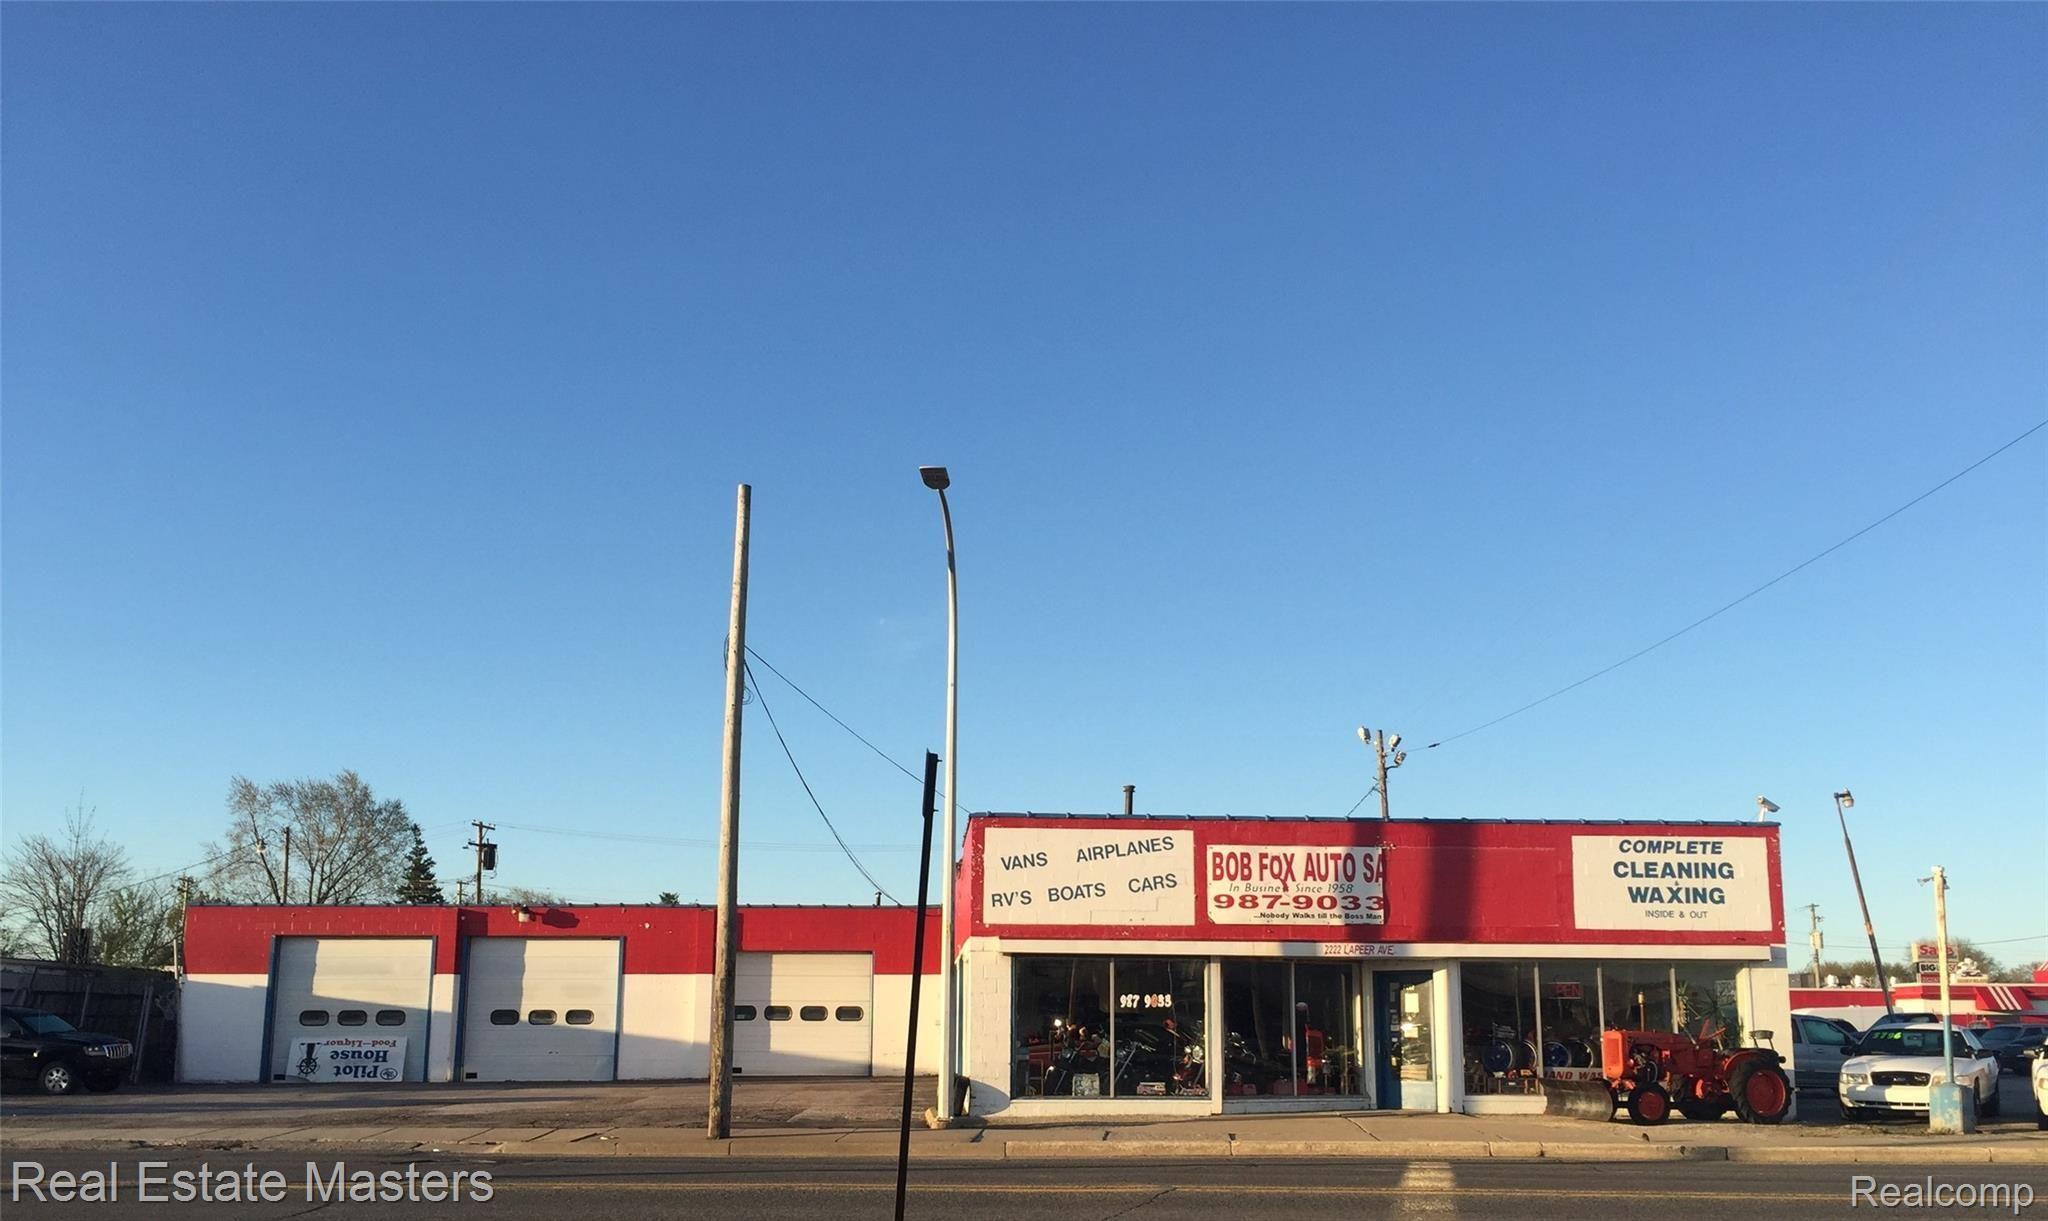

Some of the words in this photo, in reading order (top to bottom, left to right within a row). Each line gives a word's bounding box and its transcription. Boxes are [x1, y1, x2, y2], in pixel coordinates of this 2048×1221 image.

[1001, 852, 1048, 871] VANS
[1076, 836, 1175, 862] AIRPLANES
[1619, 839, 1723, 855] COMPLETE
[1212, 851, 1252, 881] BOB
[1259, 852, 1296, 891] FOX
[1303, 853, 1356, 882] AUTO
[1613, 861, 1735, 879] CLEANING
[991, 890, 1032, 907] RV'S
[1048, 883, 1106, 902] BOATS
[1128, 873, 1178, 893] CARS
[1229, 883, 1240, 893] In
[1295, 883, 1323, 893] Since
[1327, 883, 1354, 894] 1958
[1627, 886, 1726, 905] WAXING
[1213, 893, 1384, 911] 987-9033
[1345, 912, 1364, 920] Boss
[1366, 912, 1382, 920] Man
[1645, 910, 1675, 918] INSIDE
[1324, 944, 1341, 955] 2222
[1343, 944, 1375, 956] LAPEER
[1921, 964, 1936, 972] BIG
[1120, 994, 1140, 1008] 987
[330, 1050, 389, 1063] House
[334, 1065, 380, 1079] Pilot
